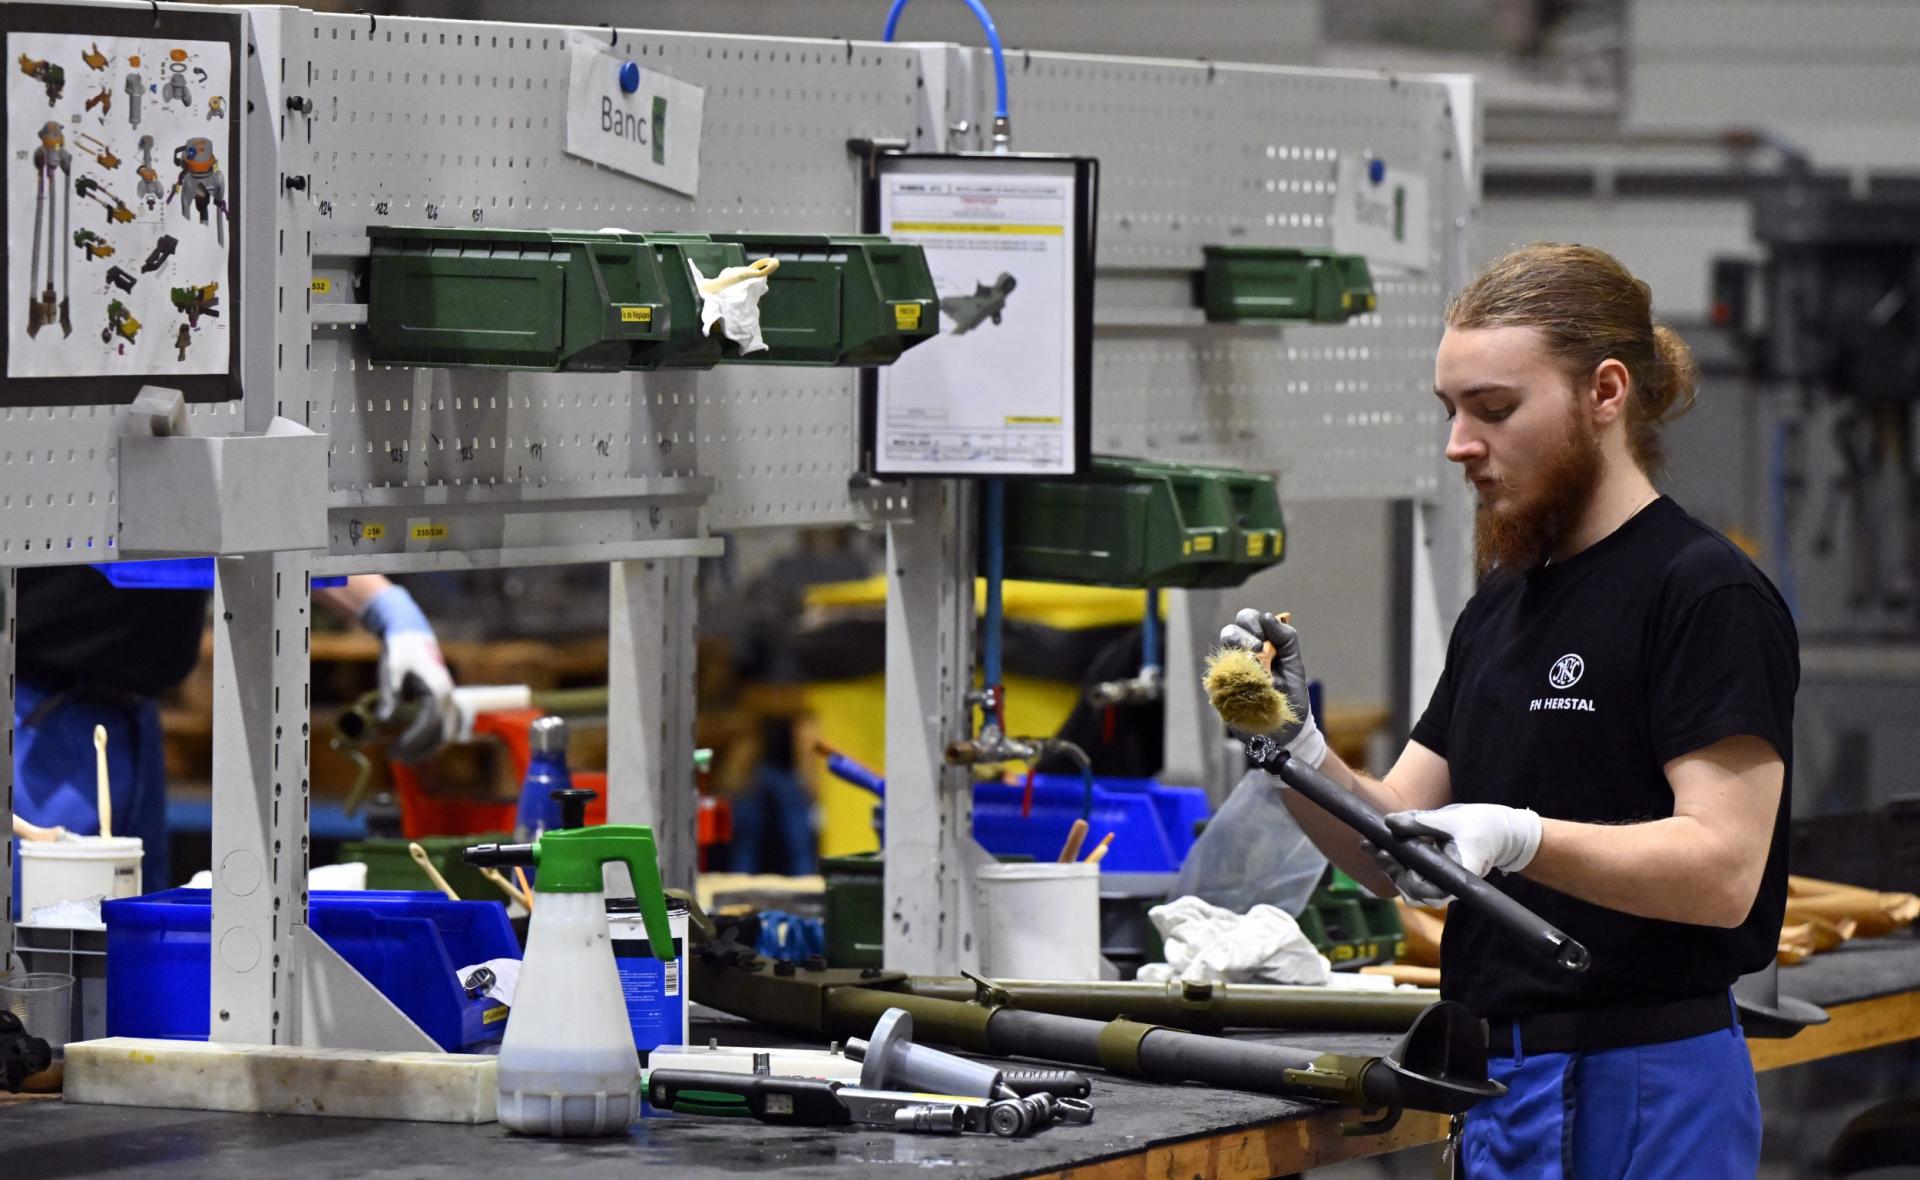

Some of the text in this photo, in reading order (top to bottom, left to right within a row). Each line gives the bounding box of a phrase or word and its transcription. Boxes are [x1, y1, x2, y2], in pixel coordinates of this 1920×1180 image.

[601, 95, 647, 145] Banc
[318, 200, 332, 219] 124
[375, 202, 389, 216] 122
[425, 203, 438, 220] 126
[1529, 698, 1596, 711] FN HERSTAL
